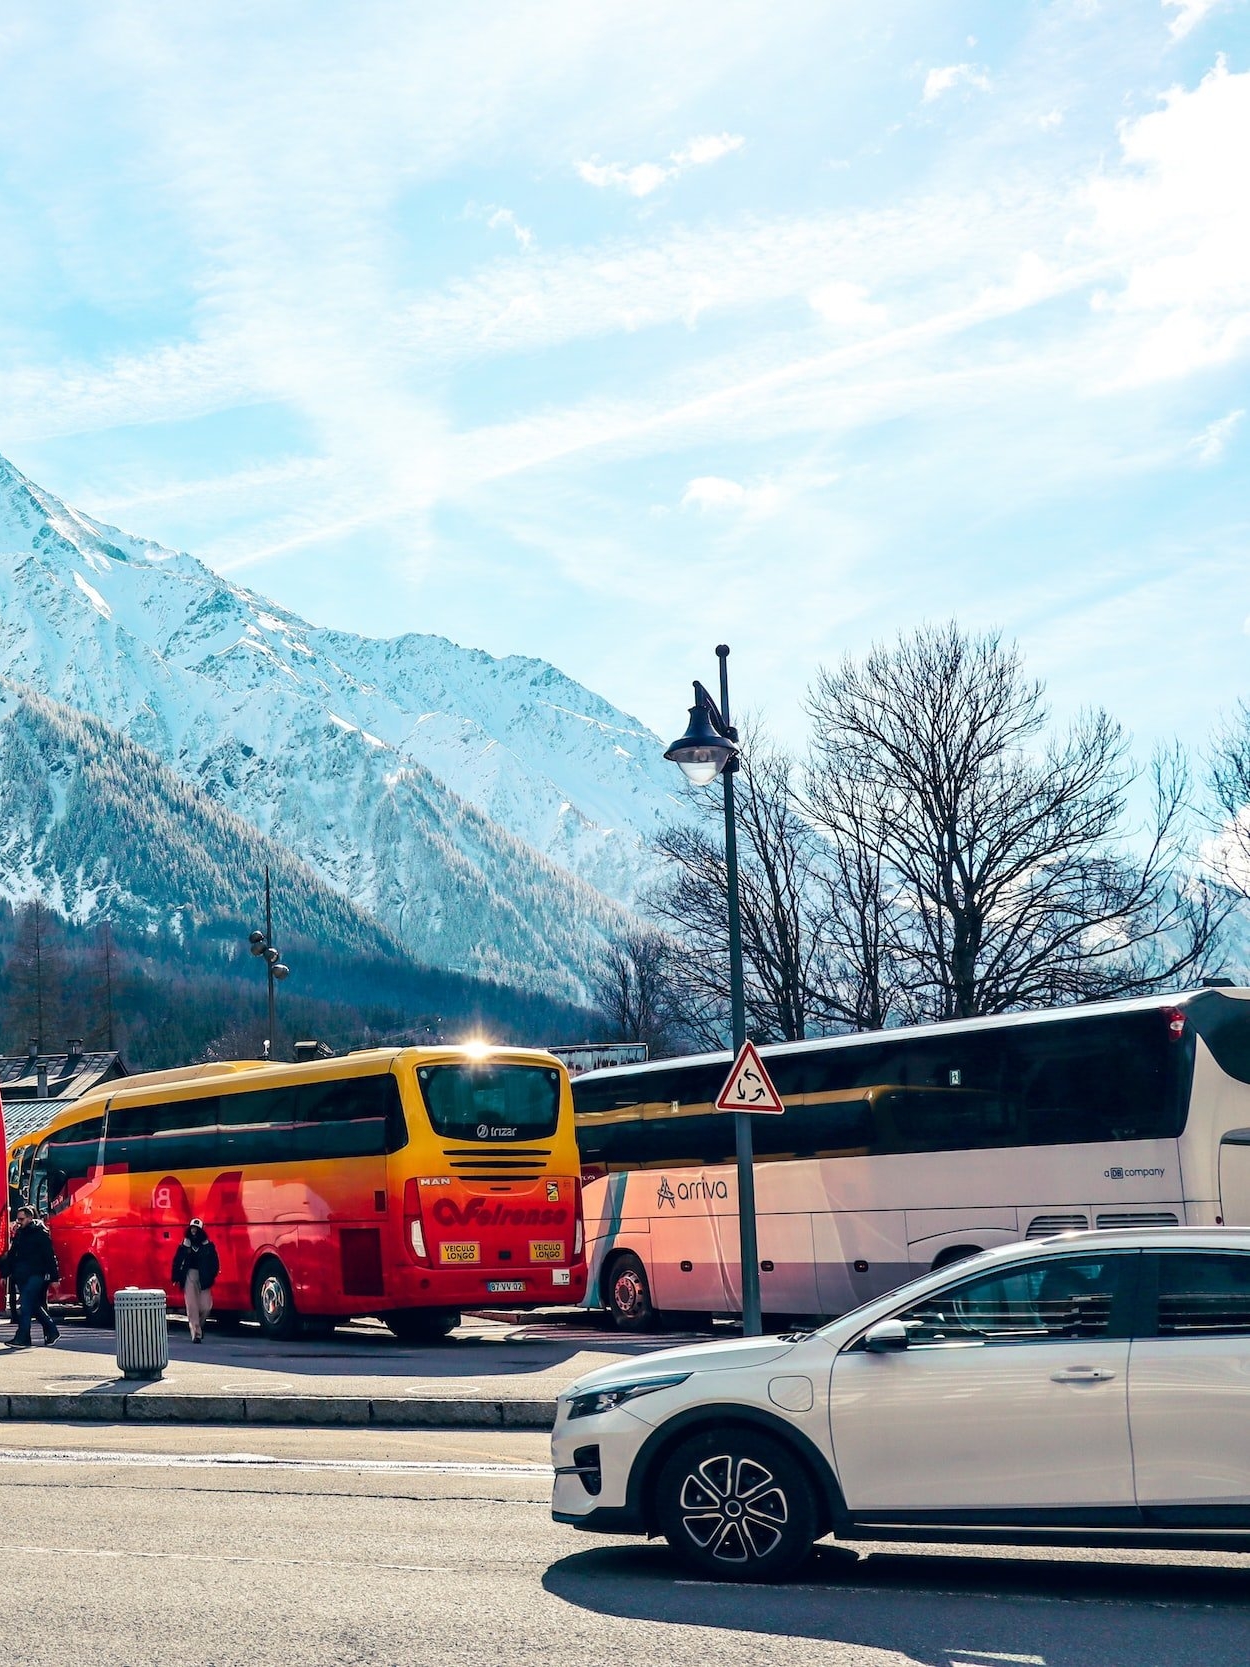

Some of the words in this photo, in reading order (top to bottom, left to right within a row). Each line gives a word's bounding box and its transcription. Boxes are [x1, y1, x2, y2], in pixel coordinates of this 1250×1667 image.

[1104, 1170, 1110, 1178] a
[1124, 1168, 1165, 1178] company
[420, 1178, 451, 1186] MAN
[677, 1176, 728, 1200] arriva
[533, 1243, 561, 1251] VEICULO
[447, 1252, 475, 1260] LONGO
[535, 1250, 560, 1258] LONGO
